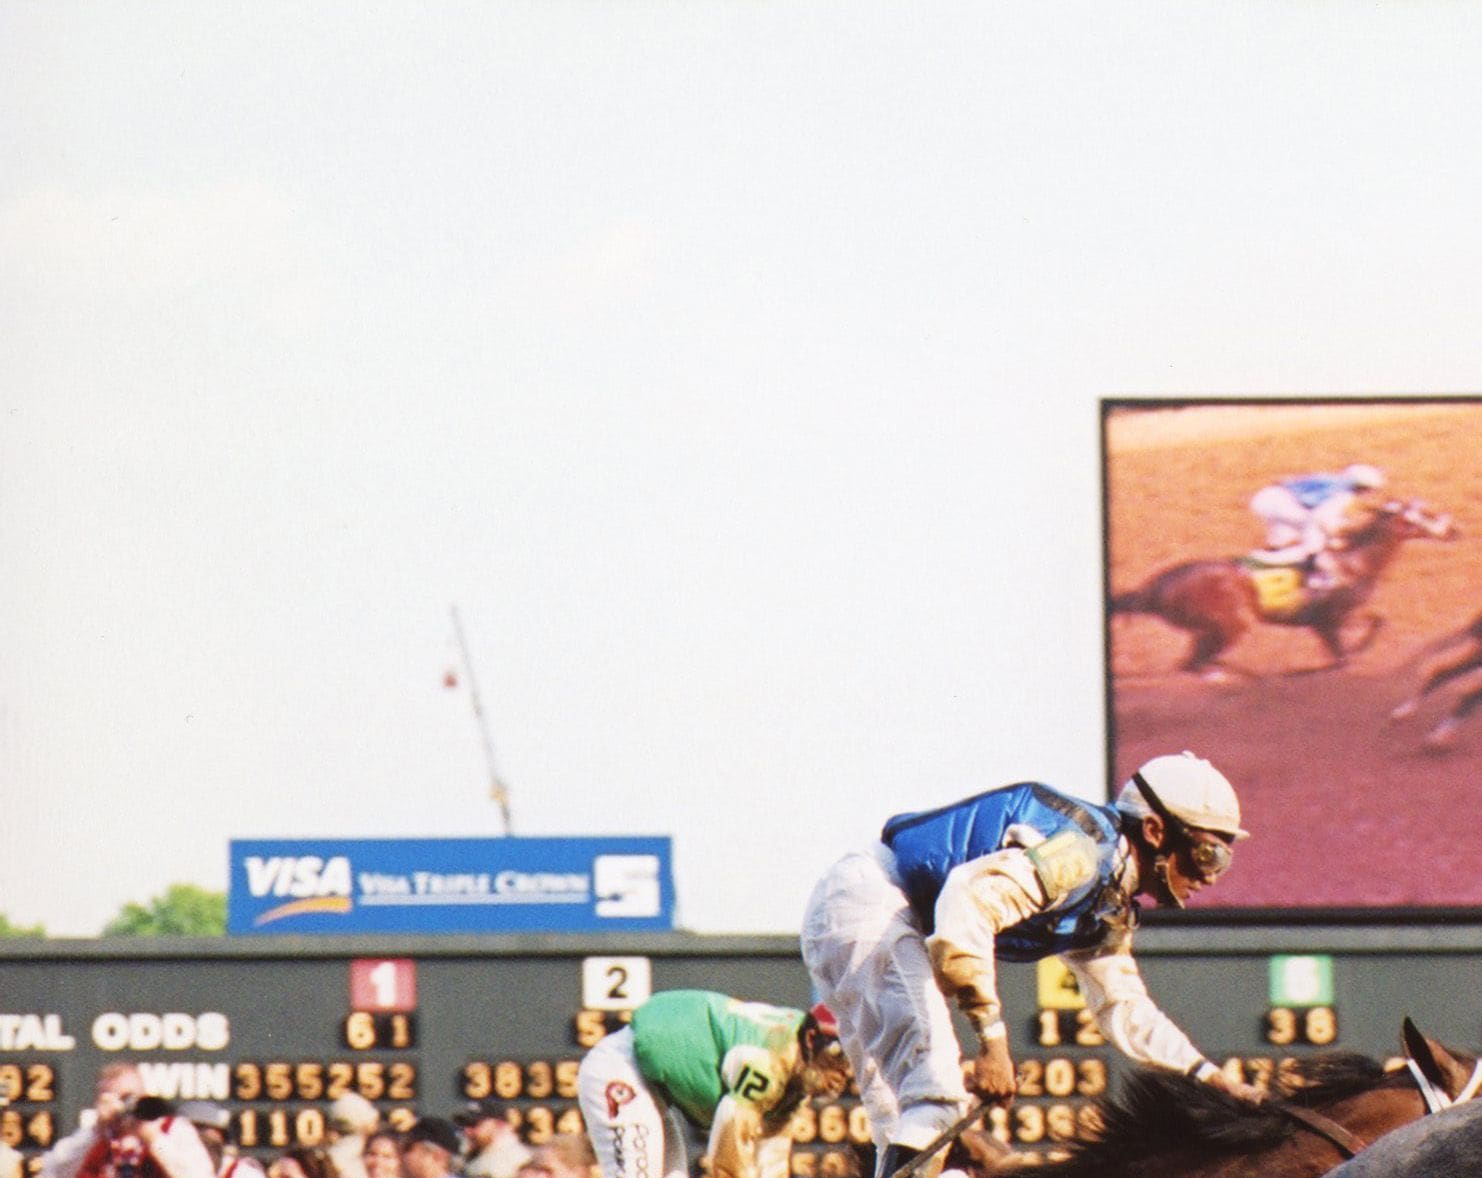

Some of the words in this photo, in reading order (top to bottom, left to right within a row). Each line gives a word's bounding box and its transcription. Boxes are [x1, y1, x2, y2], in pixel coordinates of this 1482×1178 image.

[244, 856, 351, 898] VISA
[369, 961, 397, 1007] 1
[607, 966, 629, 999] 2
[92, 1011, 230, 1051] ODDS
[137, 1062, 230, 1100] WIN
[734, 1065, 770, 1101] 12
